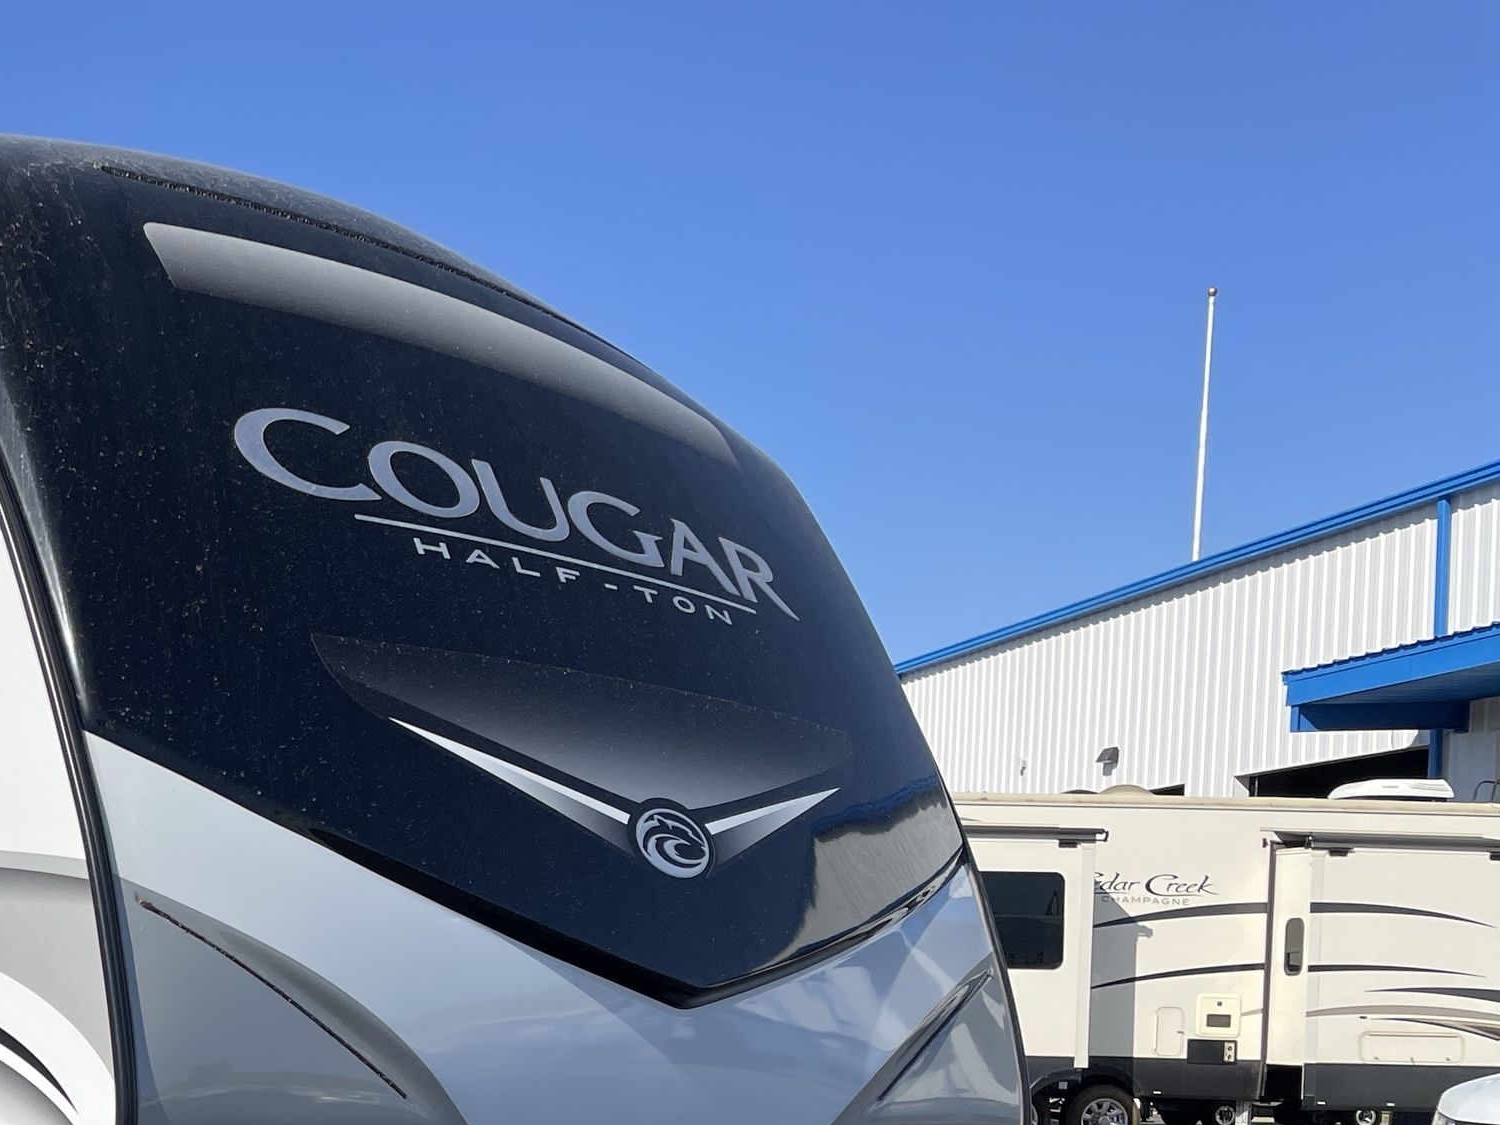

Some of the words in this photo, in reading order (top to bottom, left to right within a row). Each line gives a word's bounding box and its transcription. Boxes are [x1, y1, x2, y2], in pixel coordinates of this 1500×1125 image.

[233, 407, 800, 621] COUGAR
[413, 536, 733, 627] HALF-TON
[1101, 895, 1191, 906] CHAMPAGNE
[1144, 873, 1220, 897] Creek
